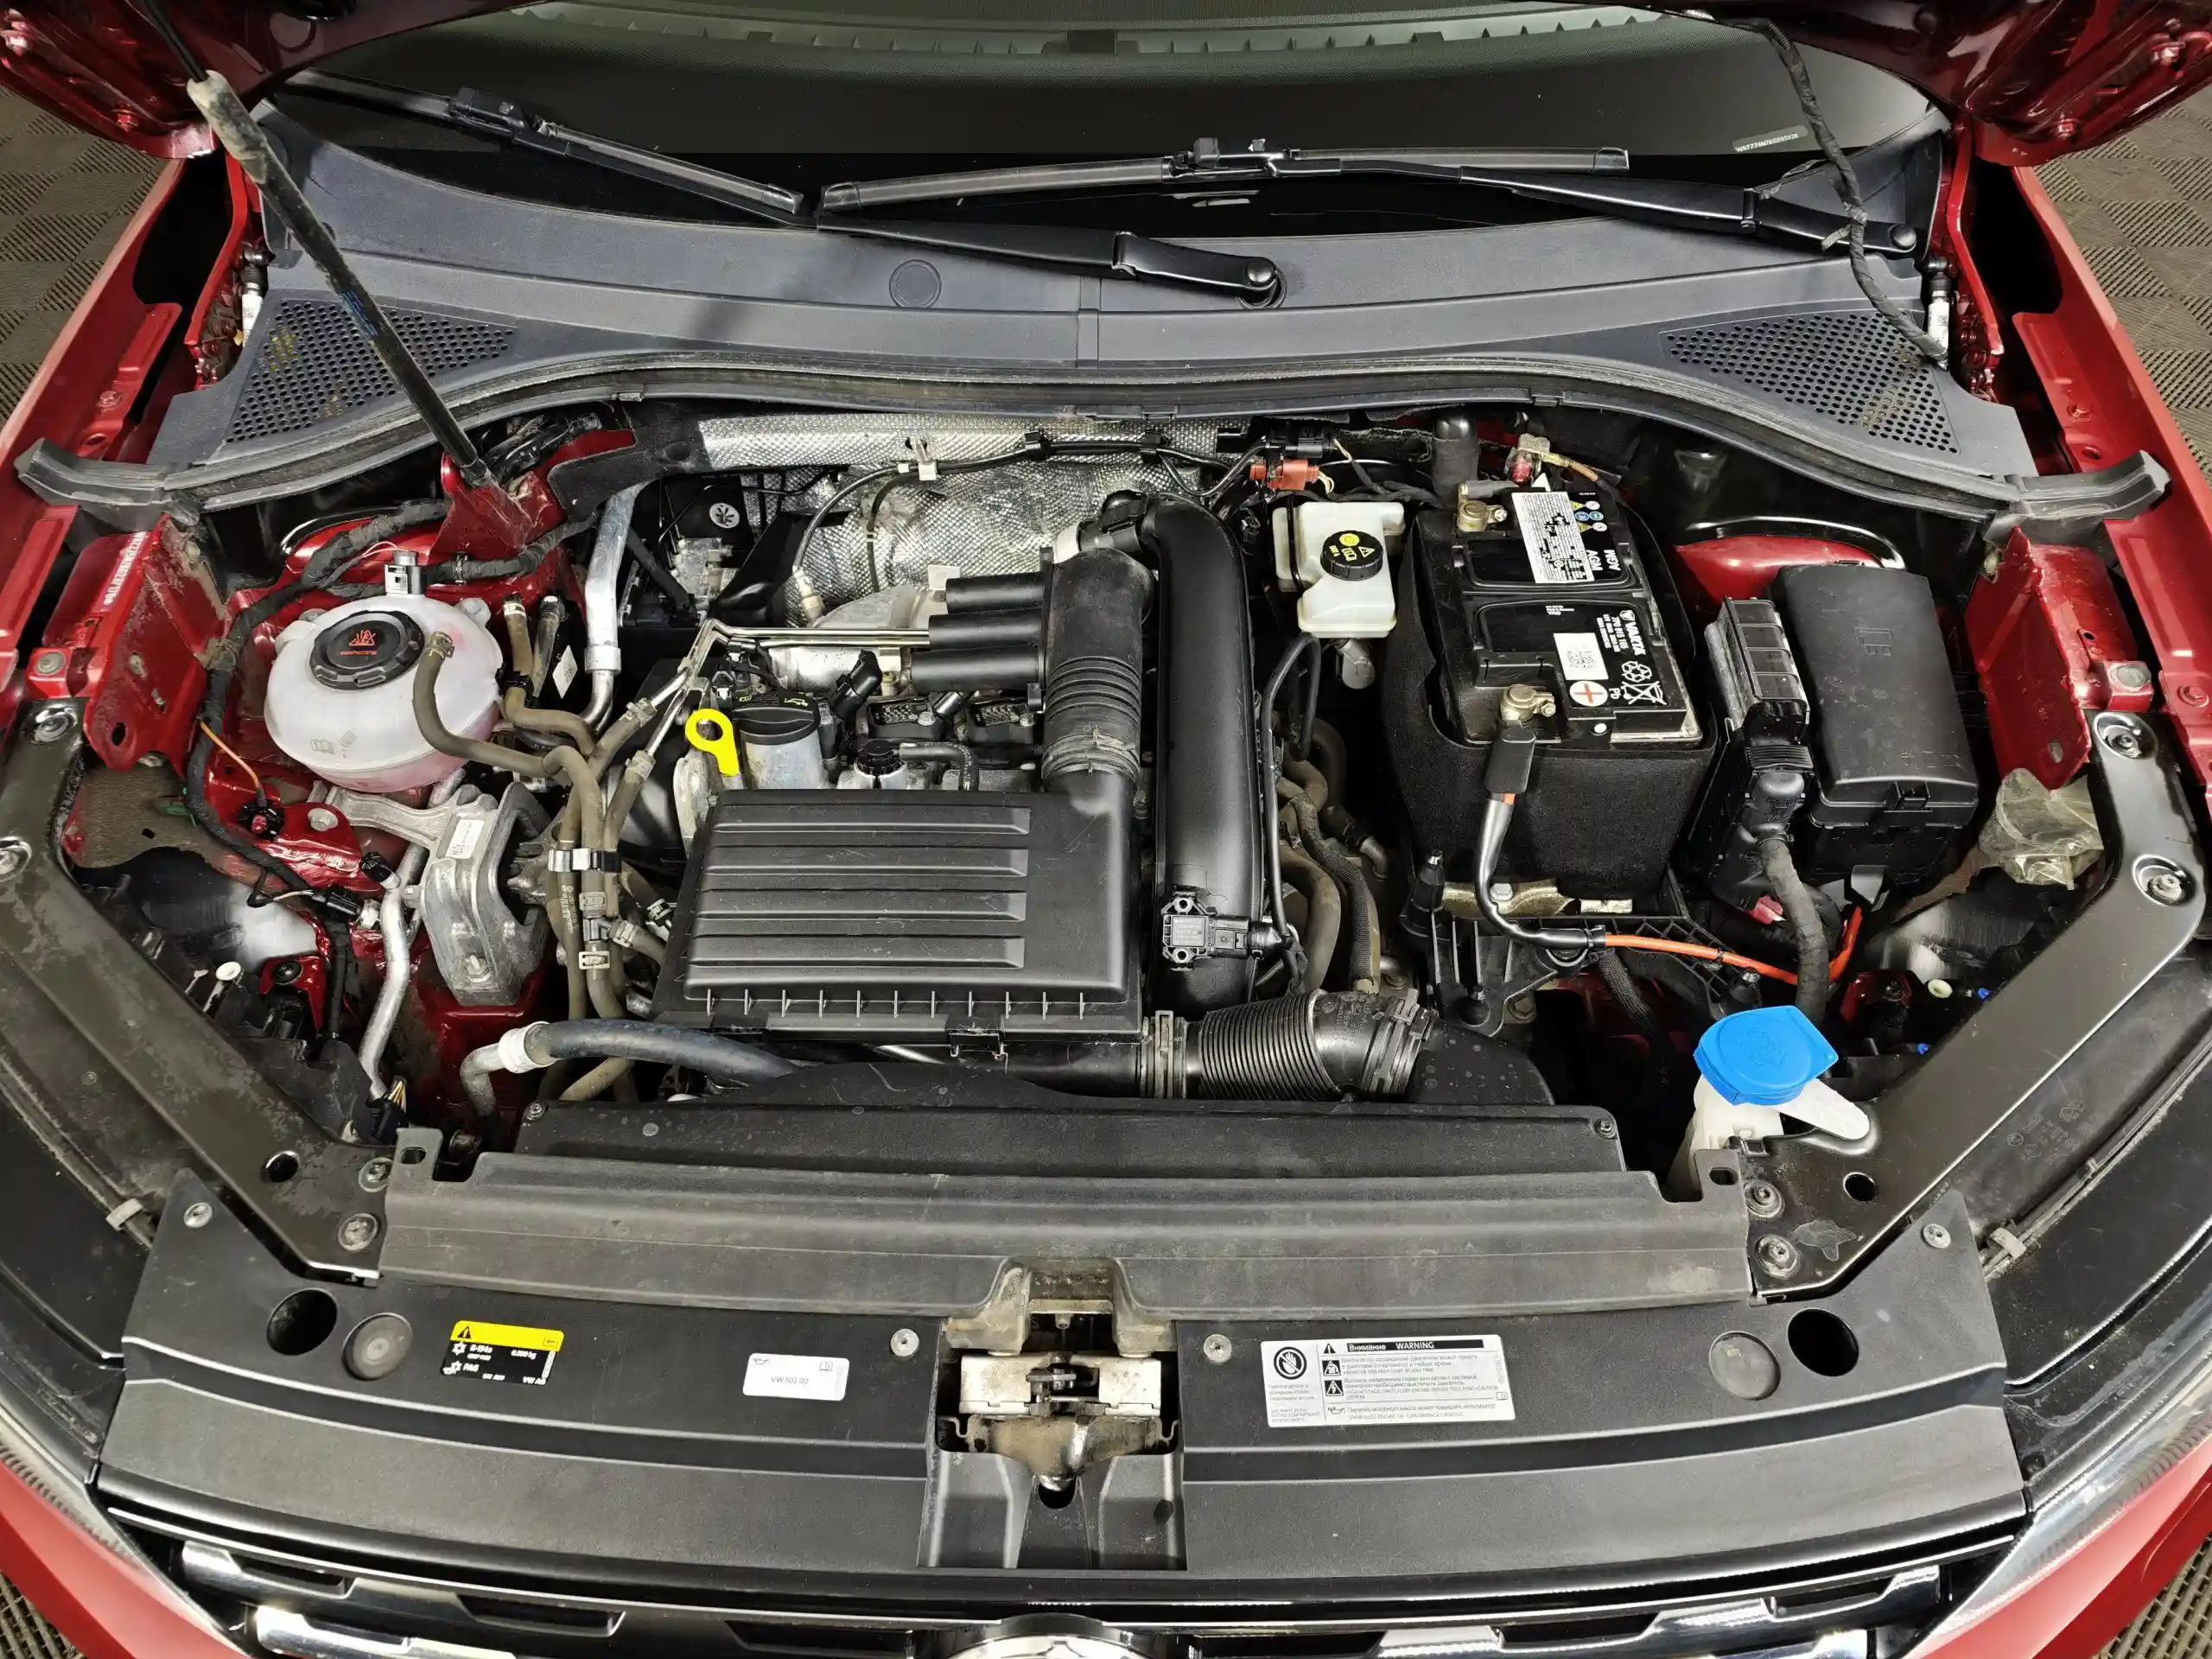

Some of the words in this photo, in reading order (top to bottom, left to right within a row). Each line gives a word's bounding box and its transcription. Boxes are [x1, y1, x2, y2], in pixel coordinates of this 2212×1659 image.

[1586, 549, 1604, 571] AGM
[1604, 549, 1621, 571] AGM
[1624, 621, 1646, 656] VARTA
[1609, 688, 1621, 700] Pb
[1348, 1343, 1387, 1351] Внимание
[1395, 1341, 1434, 1351] WARNING
